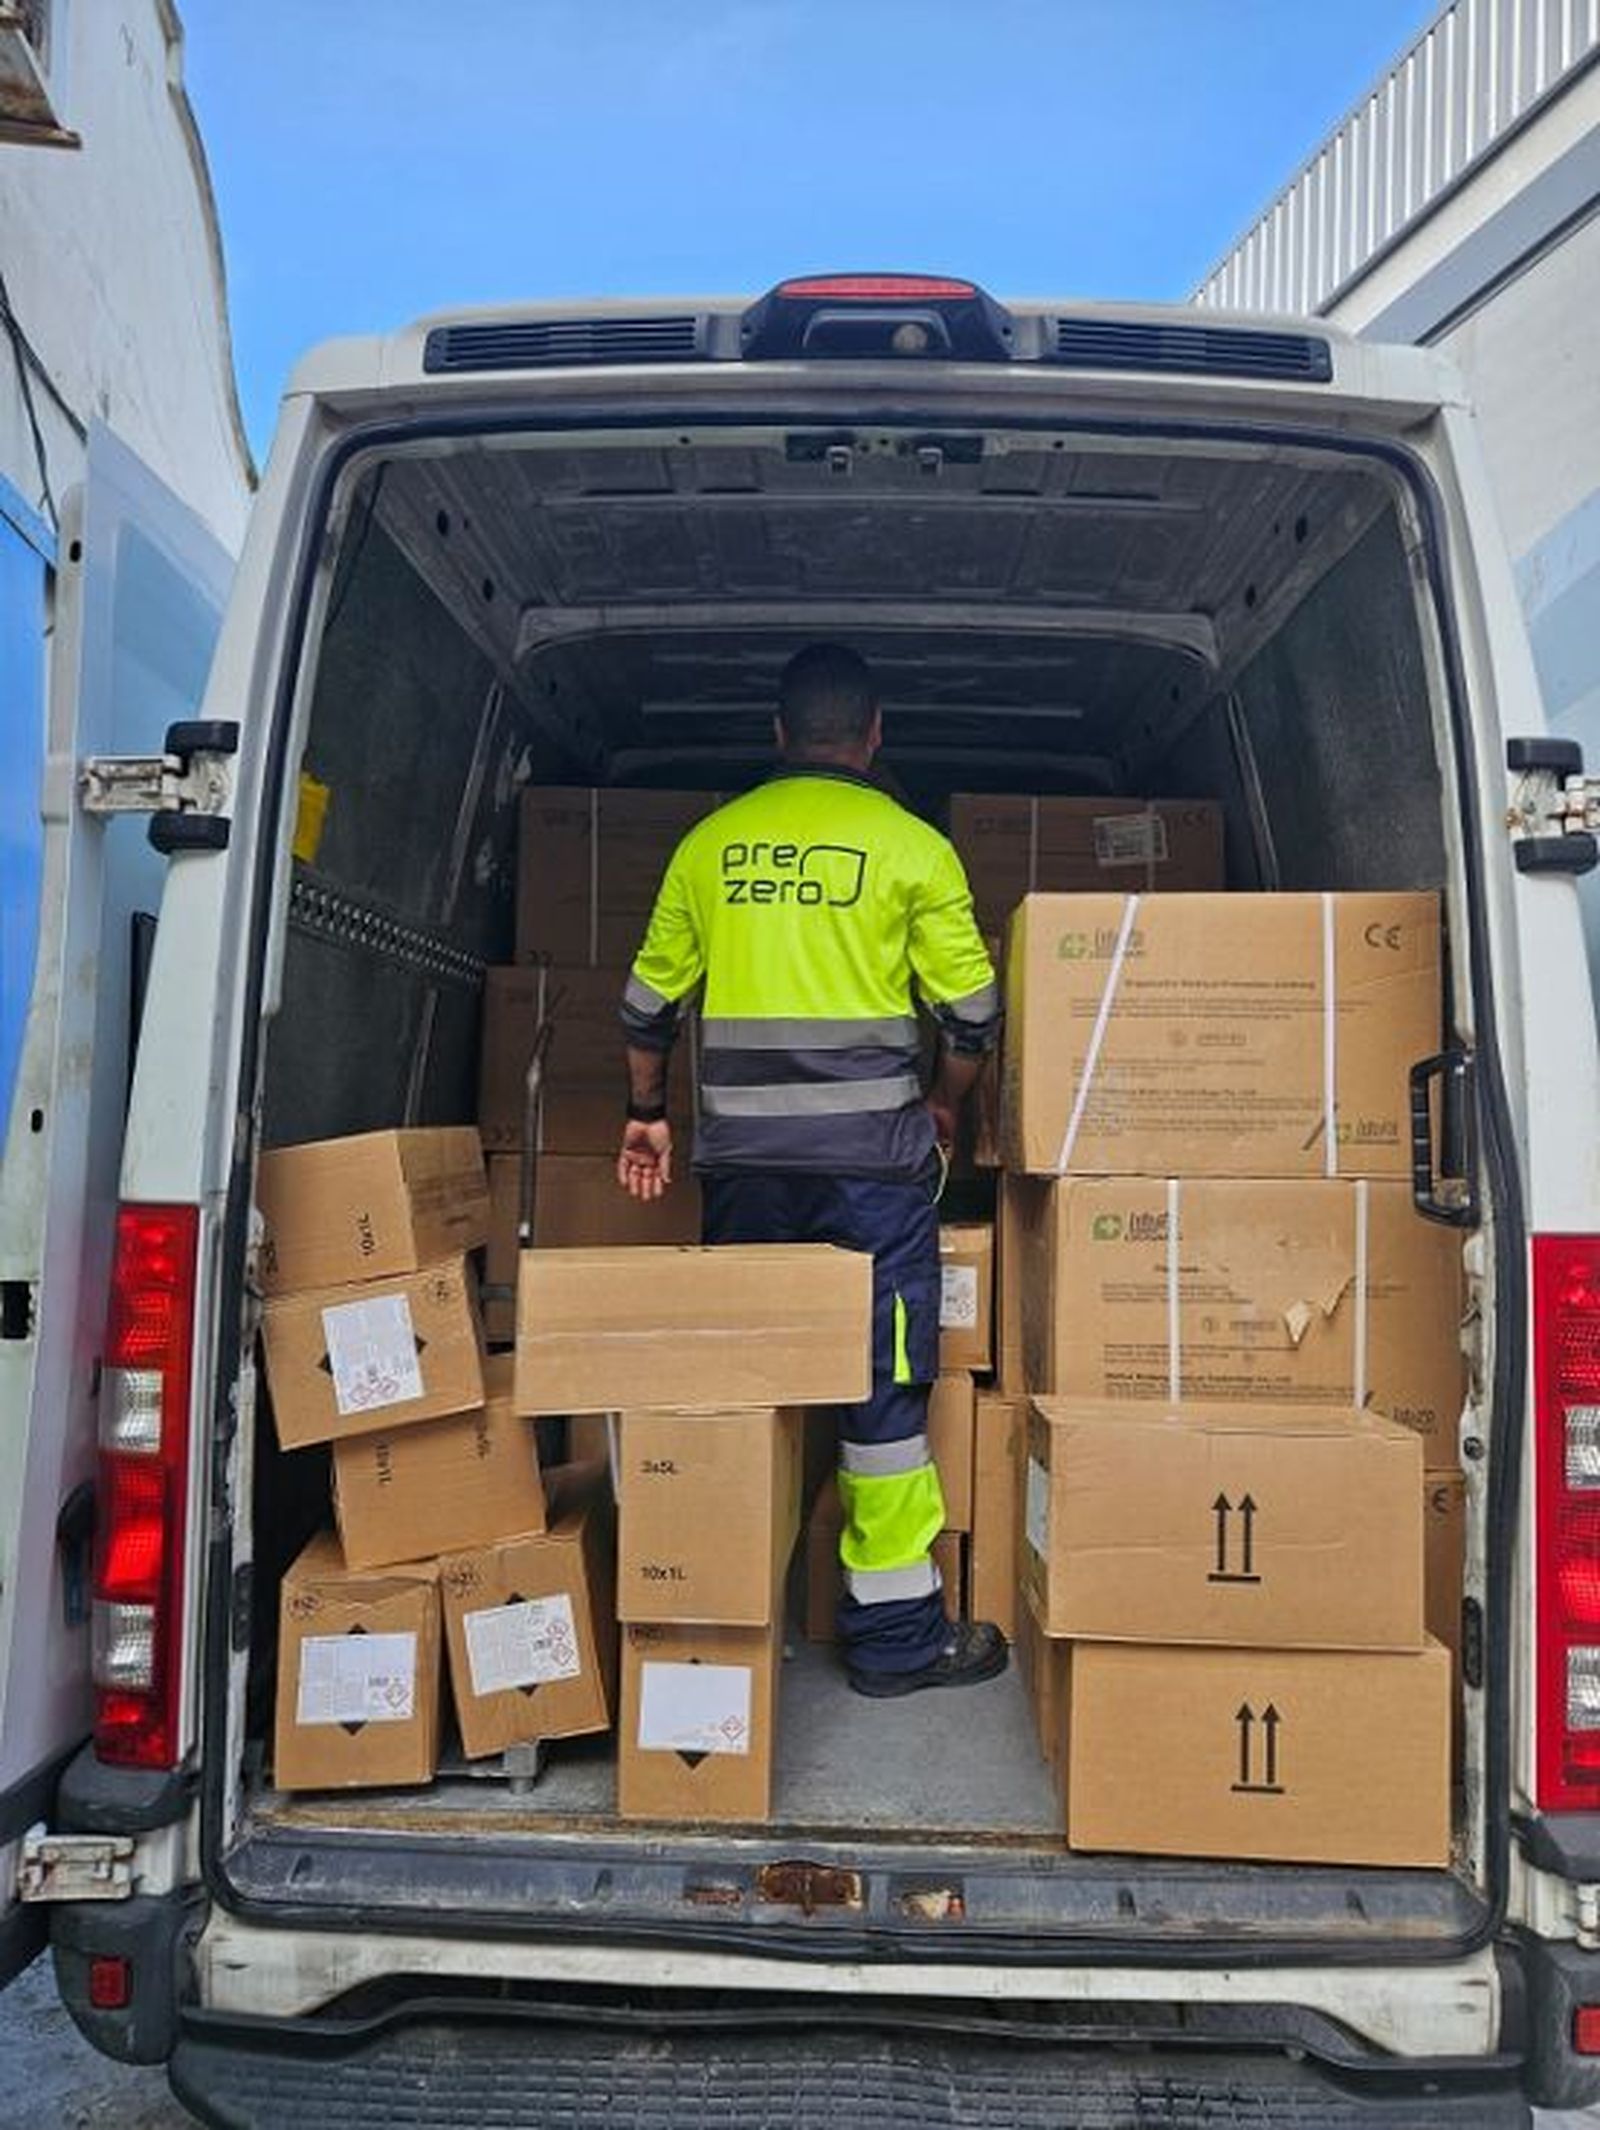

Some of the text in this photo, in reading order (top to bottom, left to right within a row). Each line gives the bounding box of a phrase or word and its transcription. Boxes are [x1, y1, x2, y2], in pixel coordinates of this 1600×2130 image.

[723, 843, 798, 876] pre
[724, 880, 822, 905] zero
[641, 1564, 688, 1581] 10x1L
